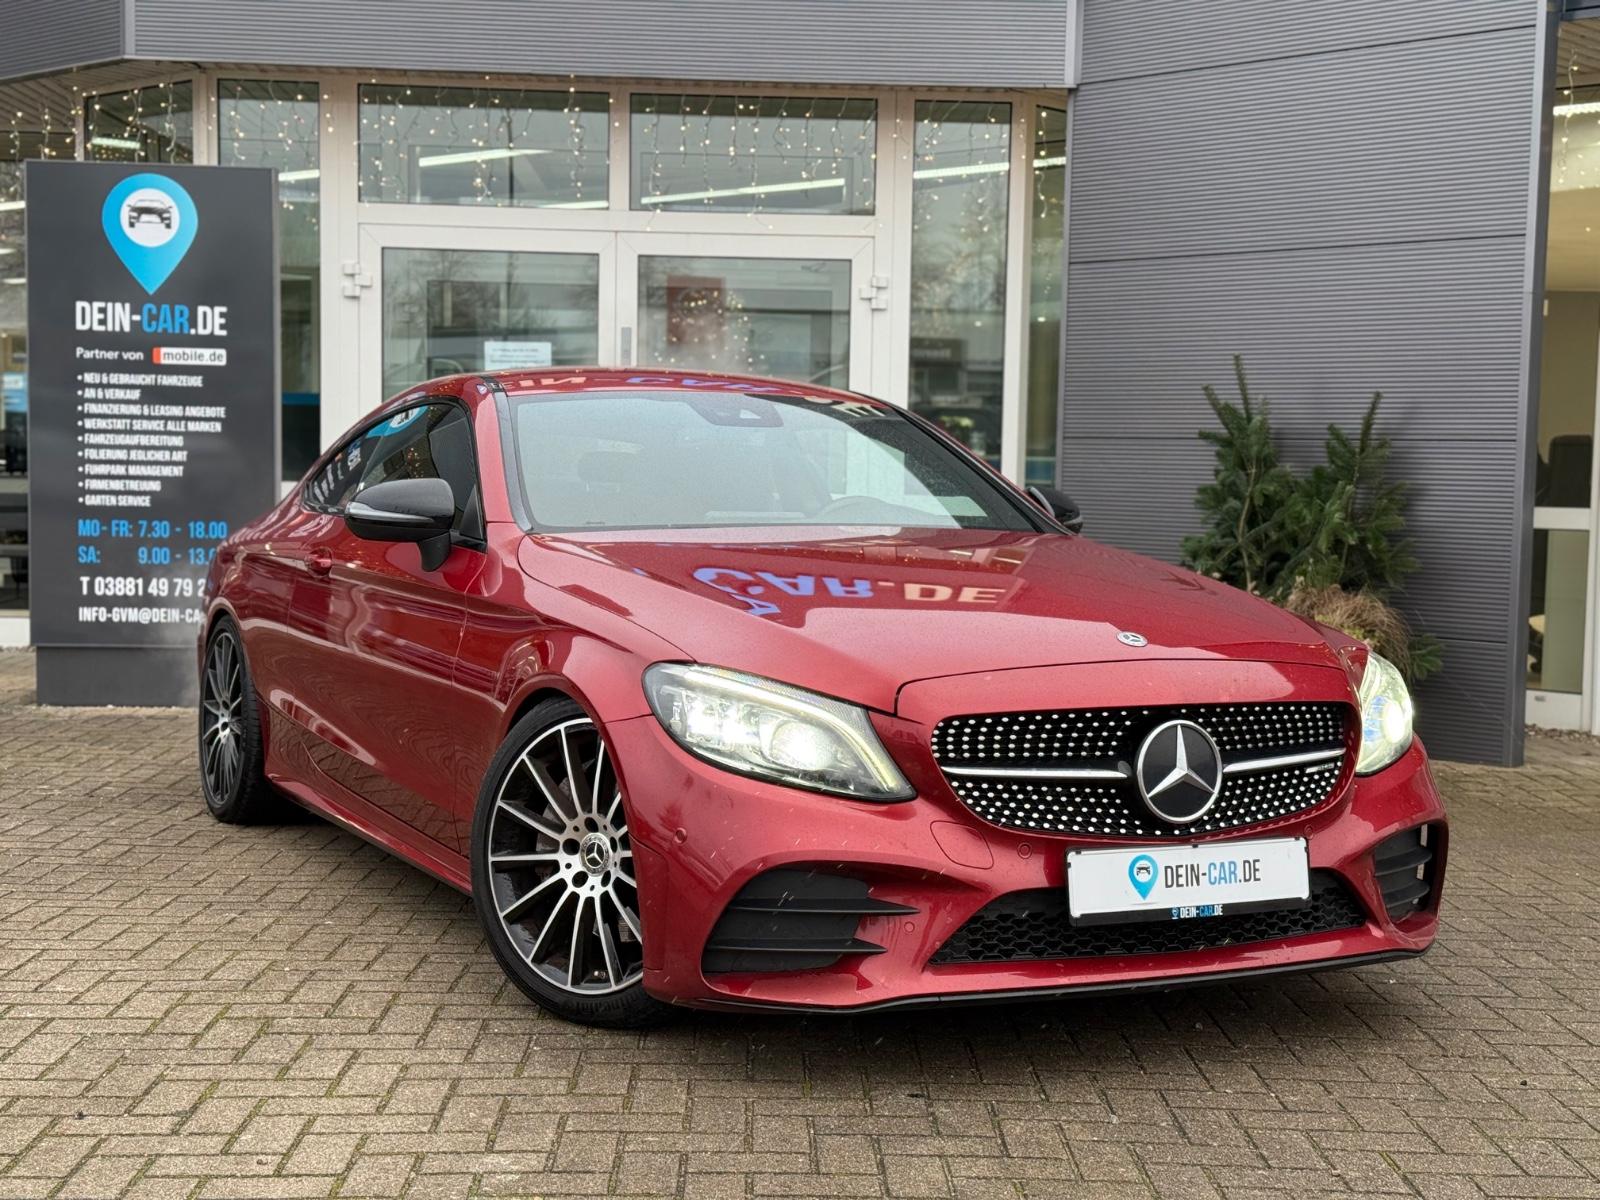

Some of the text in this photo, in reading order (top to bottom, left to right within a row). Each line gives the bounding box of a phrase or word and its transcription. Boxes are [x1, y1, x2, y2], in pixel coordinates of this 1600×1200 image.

[75, 300, 228, 336] DEIN-CAR.DE
[76, 347, 224, 362] Partner von mobile.de
[83, 372, 203, 387] NEU & GEBRAUCHT FAHRZEUGE
[83, 387, 141, 400] AN & VERKAUF
[83, 402, 226, 418] FINANZIERUNG & LEASING ANGEBOTE
[83, 418, 222, 432] WERKSTATT SERVICE ALLE MARKEN
[84, 433, 184, 447] FAHRZEUGAUFBEREITUNG
[84, 448, 188, 462] FOLIERUNG JEGLICHER ART
[84, 463, 184, 477] FUHRPARK MANAGEMENT
[84, 478, 162, 491] FIRMENBETREUUNG
[84, 494, 151, 507] GARTEN SERVICE
[111, 519, 133, 538] FR:
[138, 519, 170, 538] 7.30
[188, 521, 228, 539] 18.00
[78, 545, 101, 564] SA:
[138, 546, 170, 565] 9.00
[80, 576, 90, 596] T
[94, 576, 143, 597] 03881
[147, 577, 169, 597] 49
[173, 578, 193, 598] 79
[1164, 858, 1261, 889] DEIN-CAR.DE
[1180, 904, 1224, 919] DEIN-CAR.DE
